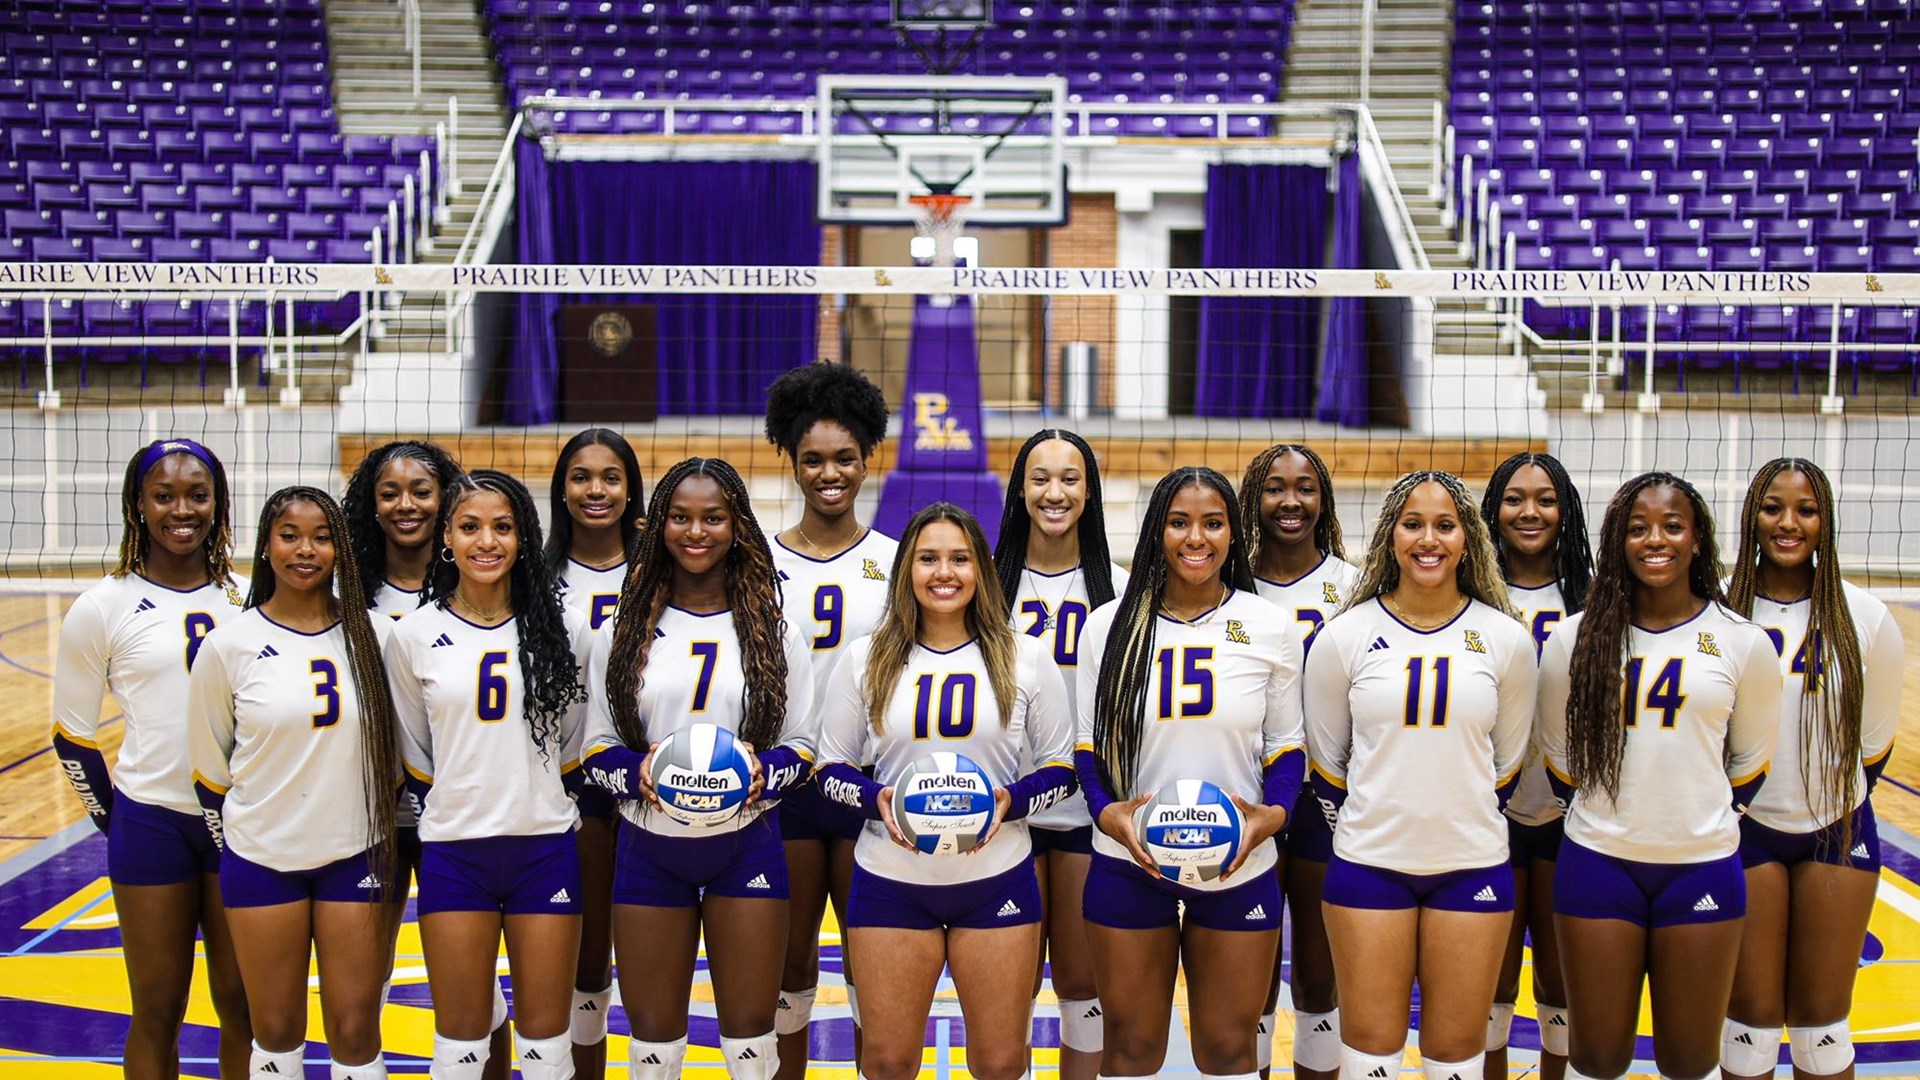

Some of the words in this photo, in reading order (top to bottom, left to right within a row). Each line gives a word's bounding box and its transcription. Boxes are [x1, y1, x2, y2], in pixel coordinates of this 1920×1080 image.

[84, 264, 157, 284] VIEW
[168, 265, 319, 285] PANTHERS
[452, 266, 569, 286] PRAIRIE
[579, 266, 654, 287] VIEW
[664, 267, 818, 287] PANTHERS
[953, 269, 1070, 289] PRAIRIE
[1079, 269, 1155, 289] VIEW
[1166, 270, 1319, 290] PANTHERS
[1452, 272, 1567, 291] PRAIRIE
[1577, 272, 1651, 291] VIEW
[1661, 272, 1811, 292] PANTHERS
[810, 581, 847, 654] 9
[184, 609, 220, 677] 8
[1019, 597, 1092, 669] 20
[475, 648, 512, 724] 6
[689, 640, 721, 713] 7
[1155, 644, 1217, 721] 15
[308, 655, 343, 731] 3
[1402, 654, 1453, 729] 11
[1619, 654, 1690, 730] 14
[911, 671, 979, 742] 10
[60, 758, 108, 817] PRAIRIE
[671, 773, 729, 790] molten
[918, 774, 976, 791] molten
[673, 791, 722, 810] NCAA
[924, 794, 972, 812] NCAA
[920, 818, 948, 832] Super
[949, 818, 976, 830] Touch
[1159, 807, 1217, 823] molten
[1162, 827, 1211, 845] NCAA
[1161, 851, 1187, 864] Super
[1189, 850, 1217, 861] Touch
[997, 908, 1021, 917] adidas
[1245, 912, 1267, 920] adidas
